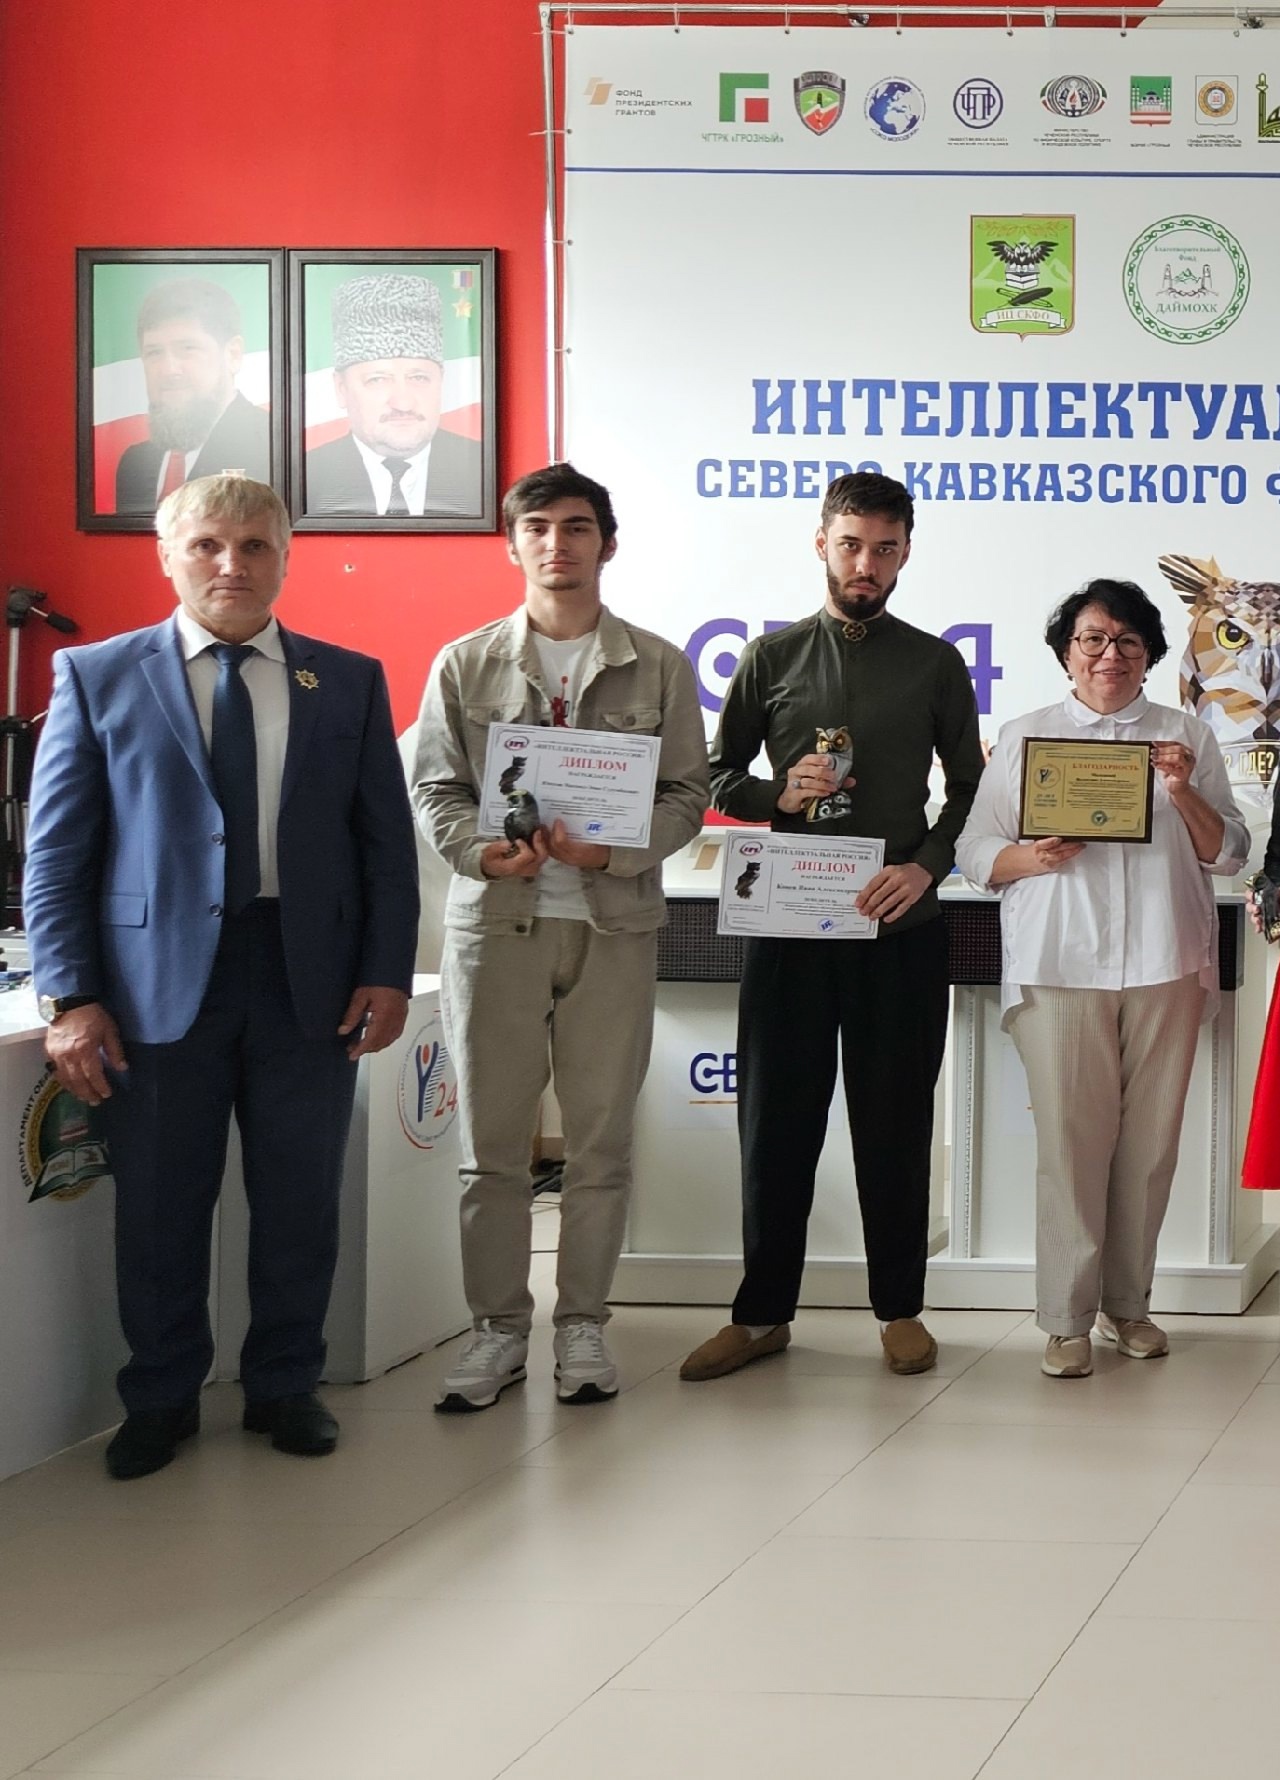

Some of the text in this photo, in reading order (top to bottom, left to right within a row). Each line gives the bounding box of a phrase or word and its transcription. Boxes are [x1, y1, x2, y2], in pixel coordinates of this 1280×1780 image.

[615, 89, 643, 98] ФОНД
[615, 99, 693, 107] ПРЕЗИДЕНТСКИХ
[615, 109, 656, 117] ГРАНТОВ
[701, 133, 729, 143] ЧГТРК
[1155, 301, 1218, 314] ДАЙМОХК
[1017, 310, 1050, 320] СКФО
[558, 756, 628, 772] ДИПЛОМ
[1239, 751, 1275, 777] ГДЕ?
[792, 860, 856, 874] ДИПЛОМ
[434, 1082, 458, 1118] 24
[18, 1093, 35, 1187] ДЕПАРТАМЕНТ
